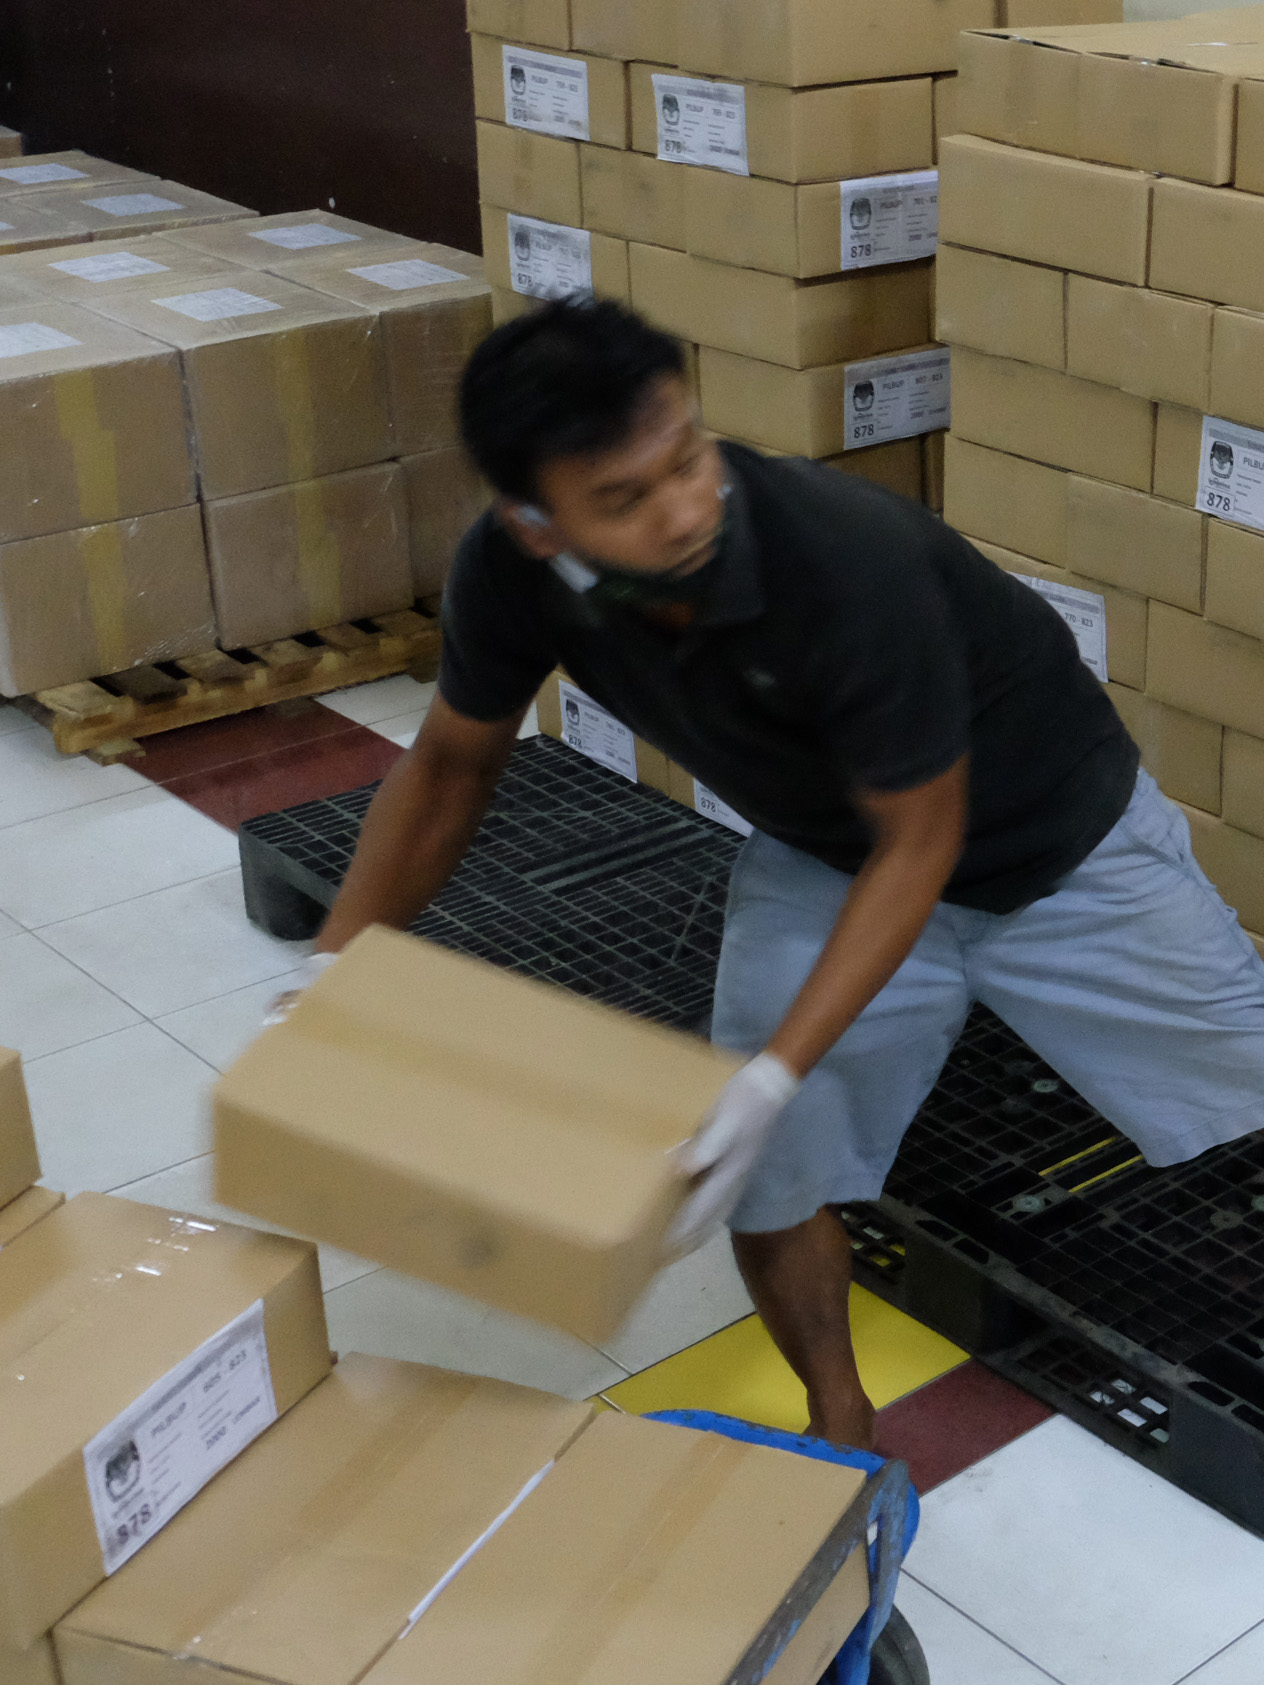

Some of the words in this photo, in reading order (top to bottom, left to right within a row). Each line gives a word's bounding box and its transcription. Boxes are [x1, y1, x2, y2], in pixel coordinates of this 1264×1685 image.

[850, 244, 872, 259] 878
[853, 424, 874, 439] 878
[1207, 492, 1231, 511] 878
[568, 734, 583, 749] 878
[701, 797, 717, 813] 878
[115, 1503, 151, 1545] 878
